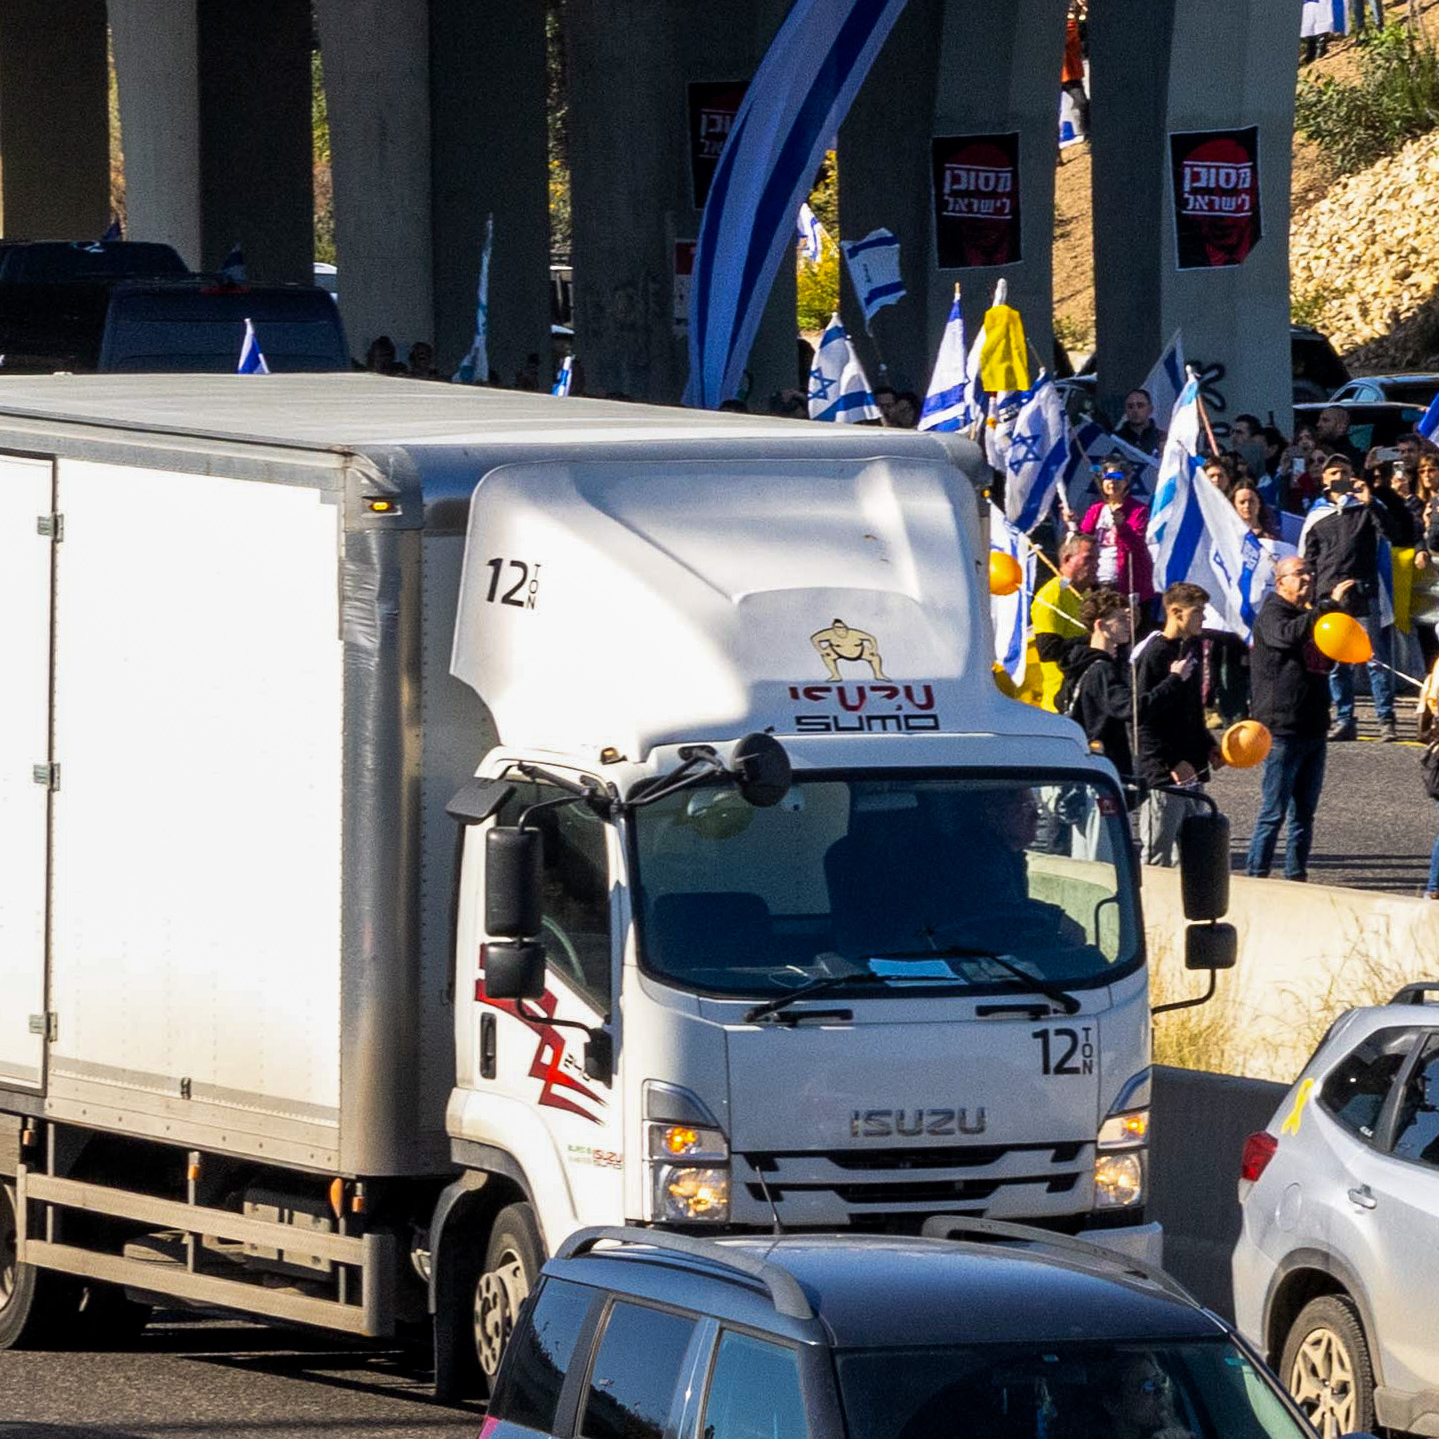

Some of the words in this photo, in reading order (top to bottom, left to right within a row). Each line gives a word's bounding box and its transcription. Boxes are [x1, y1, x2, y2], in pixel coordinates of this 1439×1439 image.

[943, 169, 1012, 194] מסוכן
[1183, 166, 1252, 192] מסוכן
[943, 196, 1011, 213] לישראל
[1183, 193, 1251, 211] לישראל
[486, 557, 529, 608] 12
[1031, 1027, 1081, 1075] 12
[1081, 1027, 1094, 1075] TON
[851, 1106, 987, 1138] ISUZU
